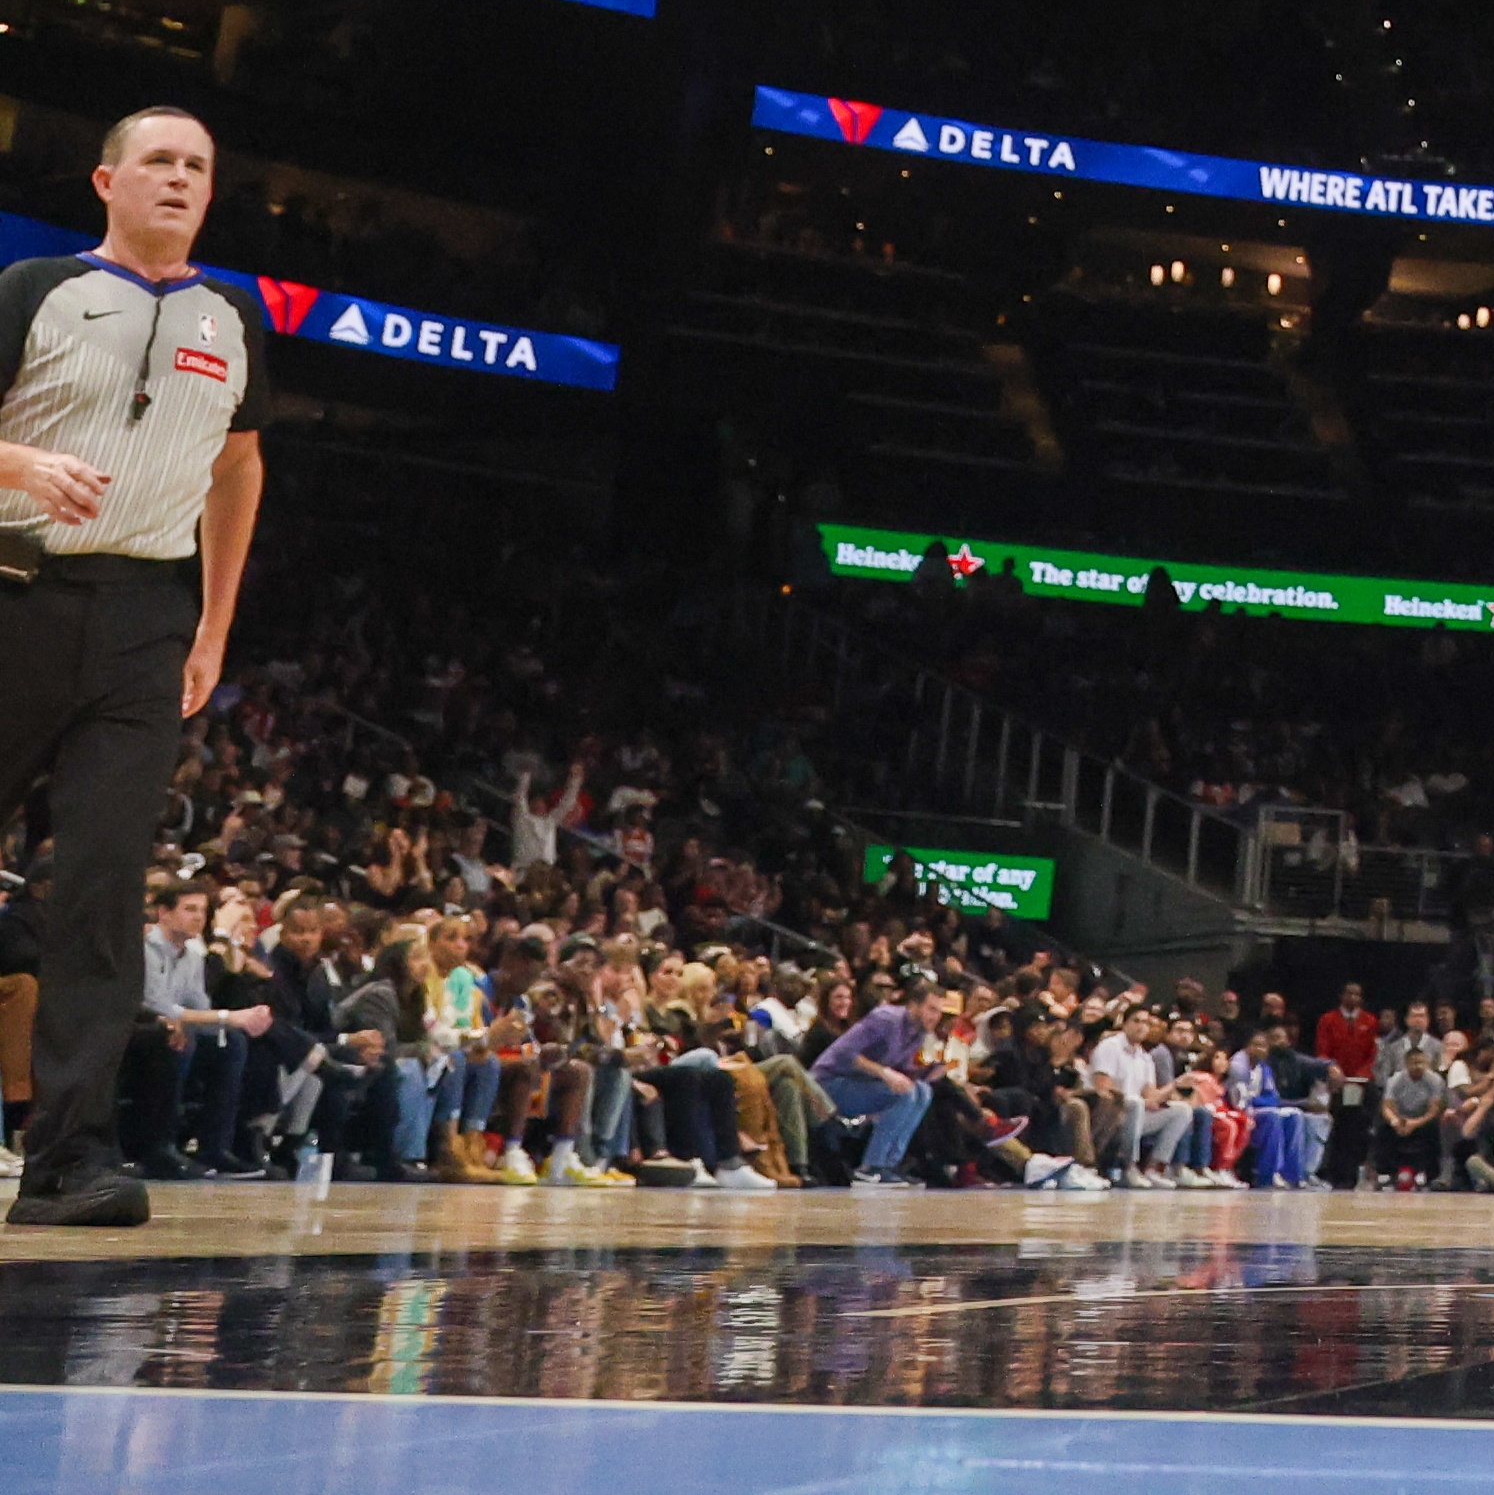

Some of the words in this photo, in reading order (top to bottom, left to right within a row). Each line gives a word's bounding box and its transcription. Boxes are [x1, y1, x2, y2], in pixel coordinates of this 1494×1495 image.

[938, 124, 1076, 171] DELTA
[1258, 165, 1363, 208] WHERE
[1365, 180, 1418, 215] ATL
[380, 312, 538, 372] DELTA
[835, 542, 924, 572] Heinek
[1029, 560, 1074, 587] The
[1075, 567, 1125, 593] star
[1199, 580, 1339, 610] celebration.
[1383, 594, 1484, 622] Heineken
